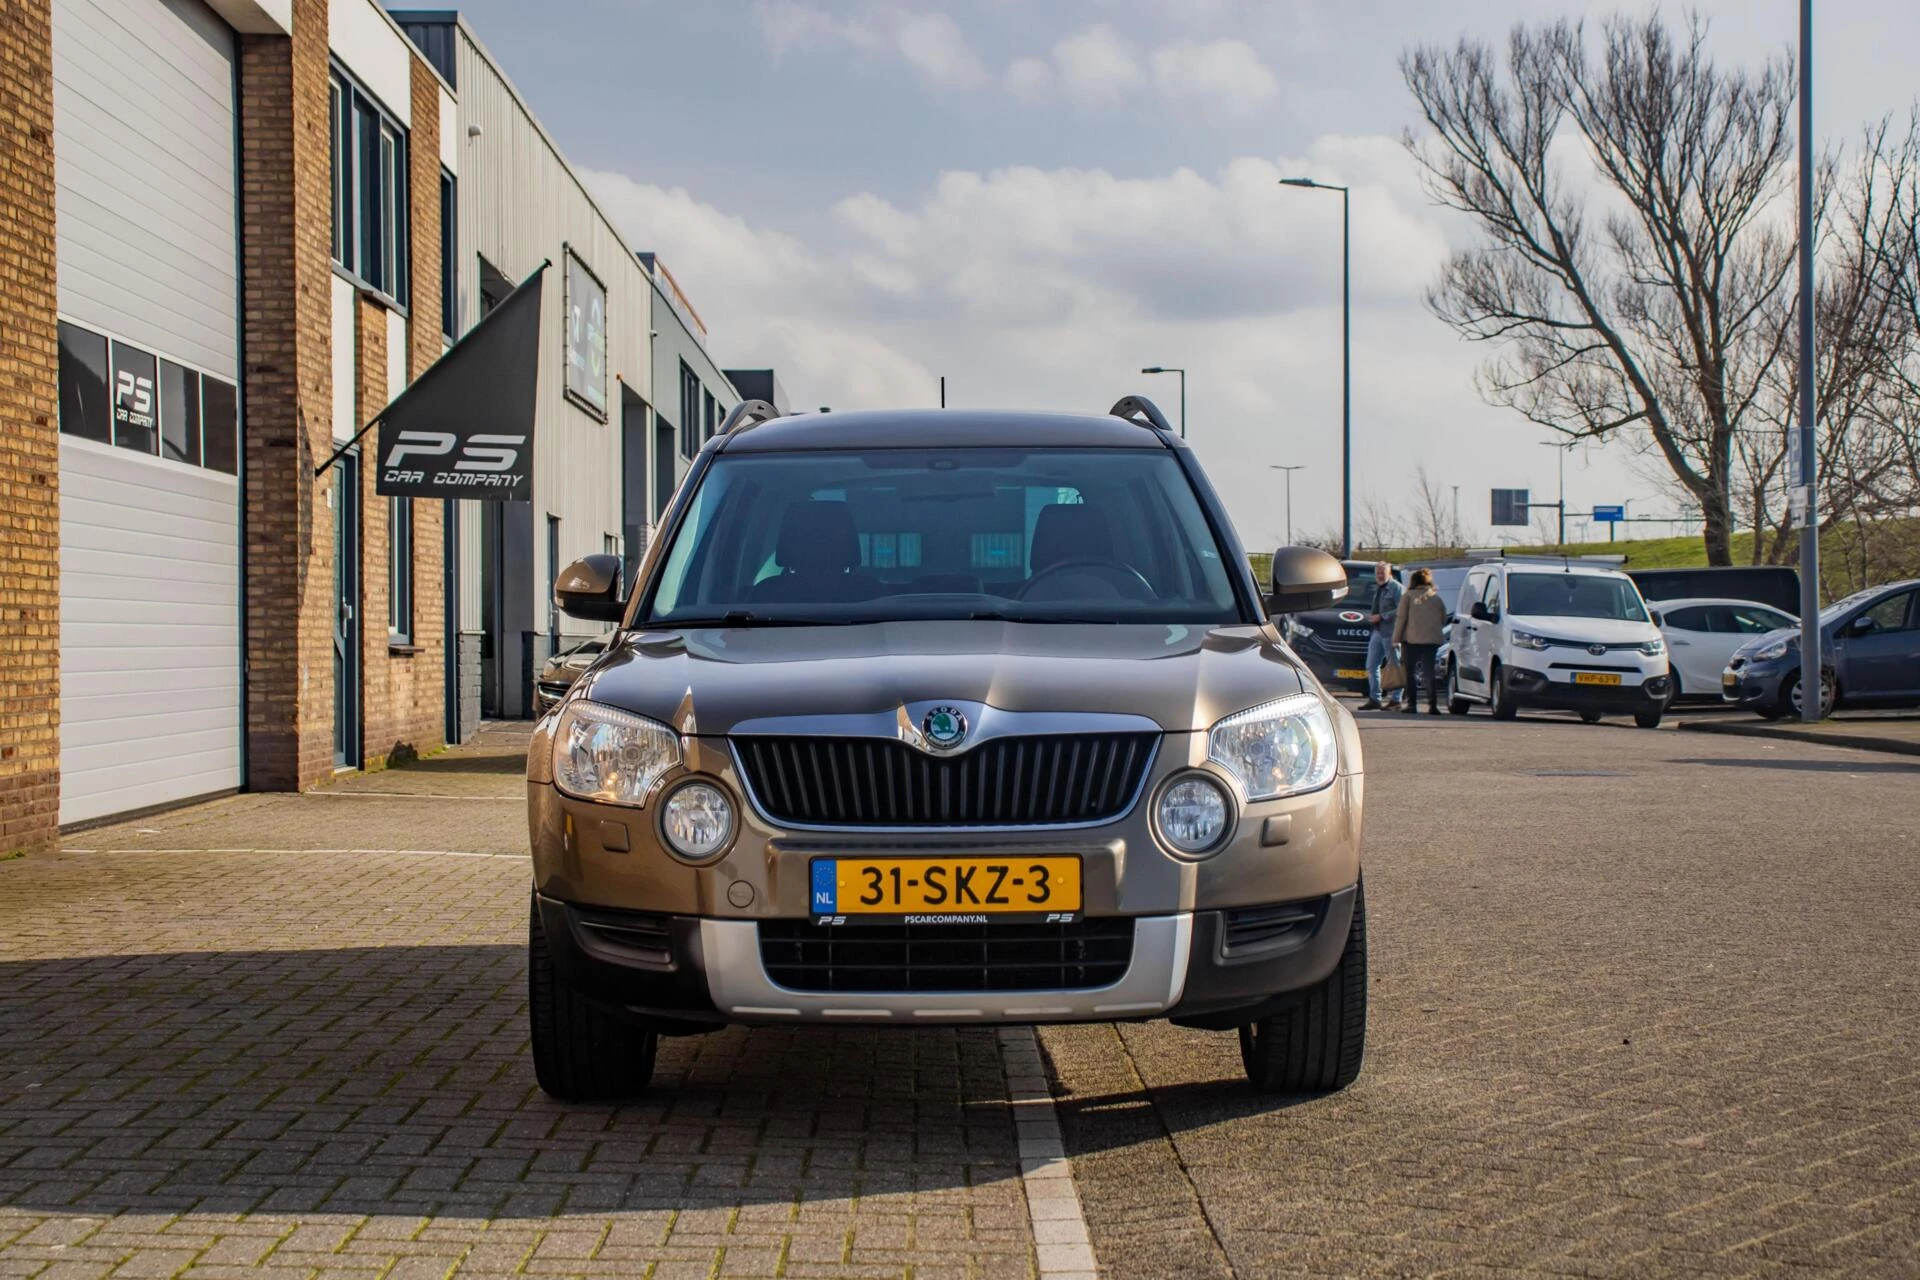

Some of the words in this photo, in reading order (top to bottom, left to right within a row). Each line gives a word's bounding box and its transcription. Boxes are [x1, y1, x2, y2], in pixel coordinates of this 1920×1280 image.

[116, 370, 152, 413] PS
[117, 408, 128, 421] CAR
[129, 411, 153, 428] COMPANY
[385, 430, 526, 471] PS
[384, 470, 424, 483] CAR
[433, 472, 523, 487] COMPANY
[1337, 628, 1370, 637] IVECO
[816, 892, 833, 904] NL
[860, 865, 1050, 905] 31-SKZ-3
[818, 916, 847, 925] PS
[904, 915, 988, 924] PSCARCOMPANY.NL
[1046, 913, 1074, 923] PS
